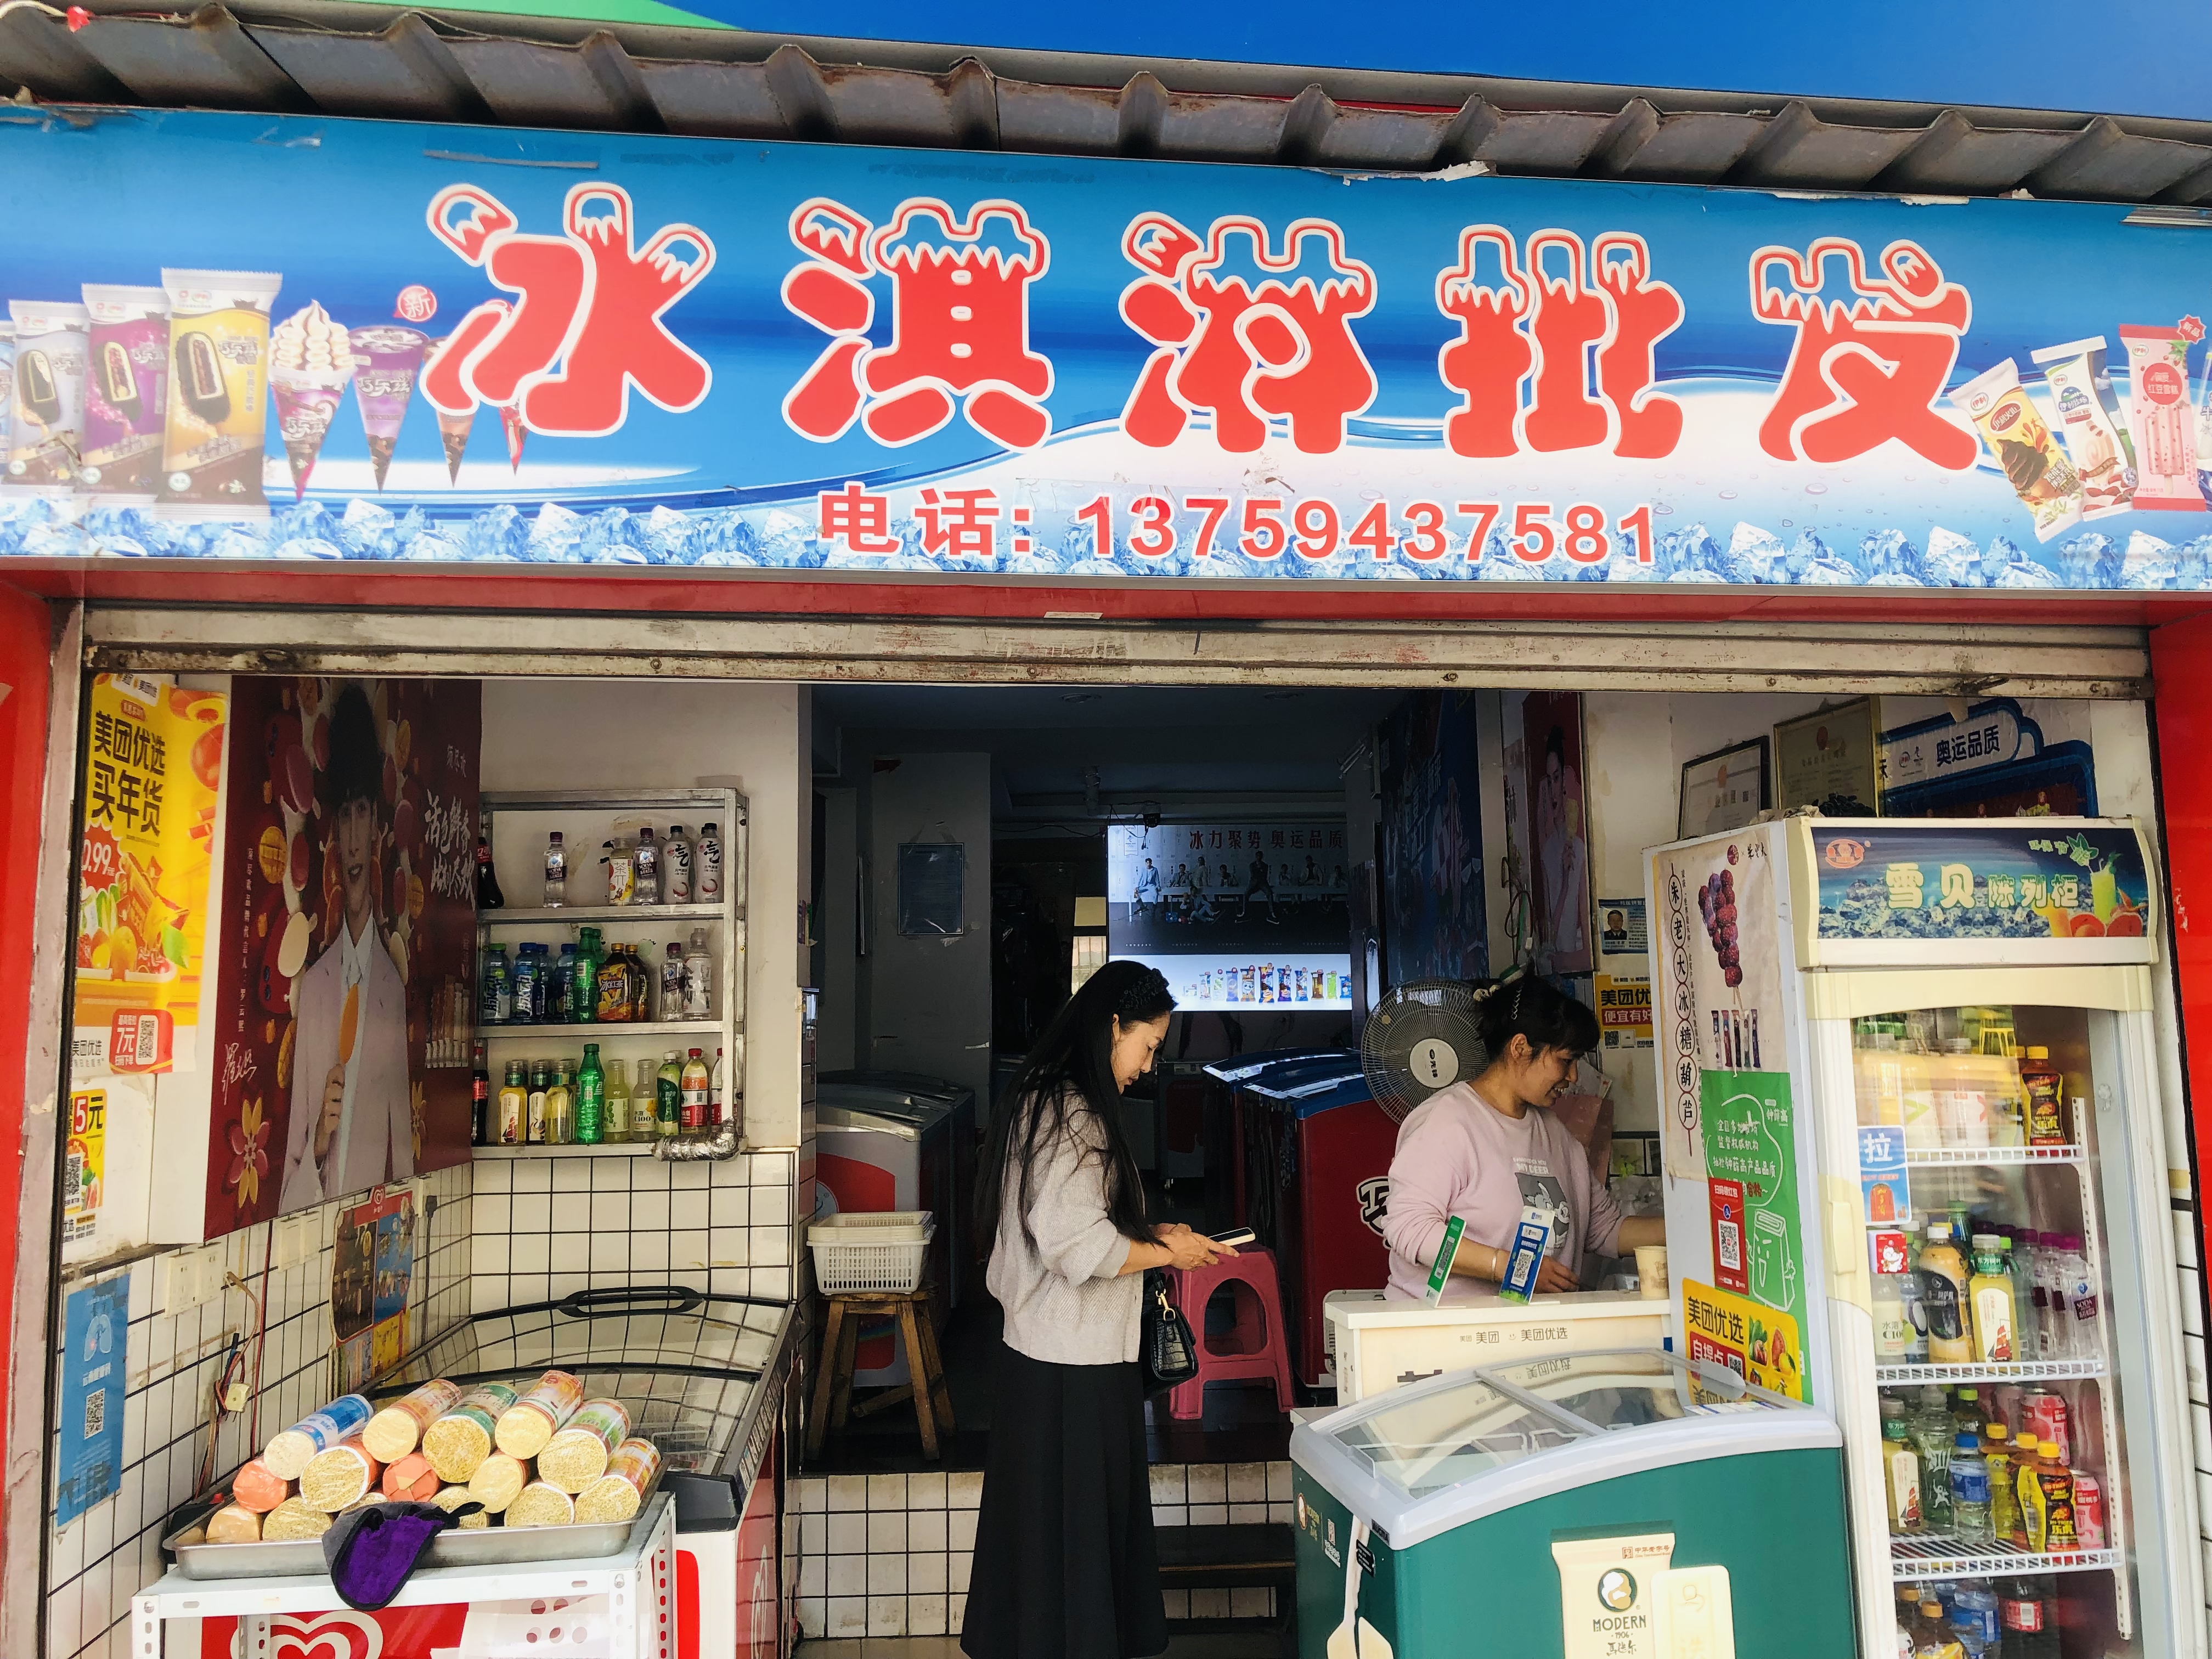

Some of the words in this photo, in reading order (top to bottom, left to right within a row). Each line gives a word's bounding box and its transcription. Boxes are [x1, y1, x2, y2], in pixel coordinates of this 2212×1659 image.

[405, 292, 431, 318] 新
[424, 181, 1979, 471] 冰淇淋批发
[2183, 321, 2200, 338] 新品
[1972, 396, 1987, 409] 伊利
[1077, 491, 1657, 569] 13759437581
[94, 711, 166, 778] 美团优选
[1936, 724, 2001, 768] 奥运品质
[91, 759, 163, 837] 买年货
[1189, 829, 1262, 850] 冰力聚势
[1271, 828, 1344, 850] 奥运品质
[1885, 861, 1976, 911] 雪贝
[1987, 873, 2079, 909] 陈列柜
[1669, 881, 1695, 1125] 朱老大冰糖葫芦
[116, 1027, 136, 1054] 7元
[1864, 1132, 1893, 1164] 拉
[1476, 1330, 1500, 1344] 美团
[1521, 1327, 1568, 1342] 美团优选
[1688, 1295, 1744, 1346] 美团优选
[1882, 1330, 1904, 1339] C10
[1593, 1615, 1646, 1632] MODERN
